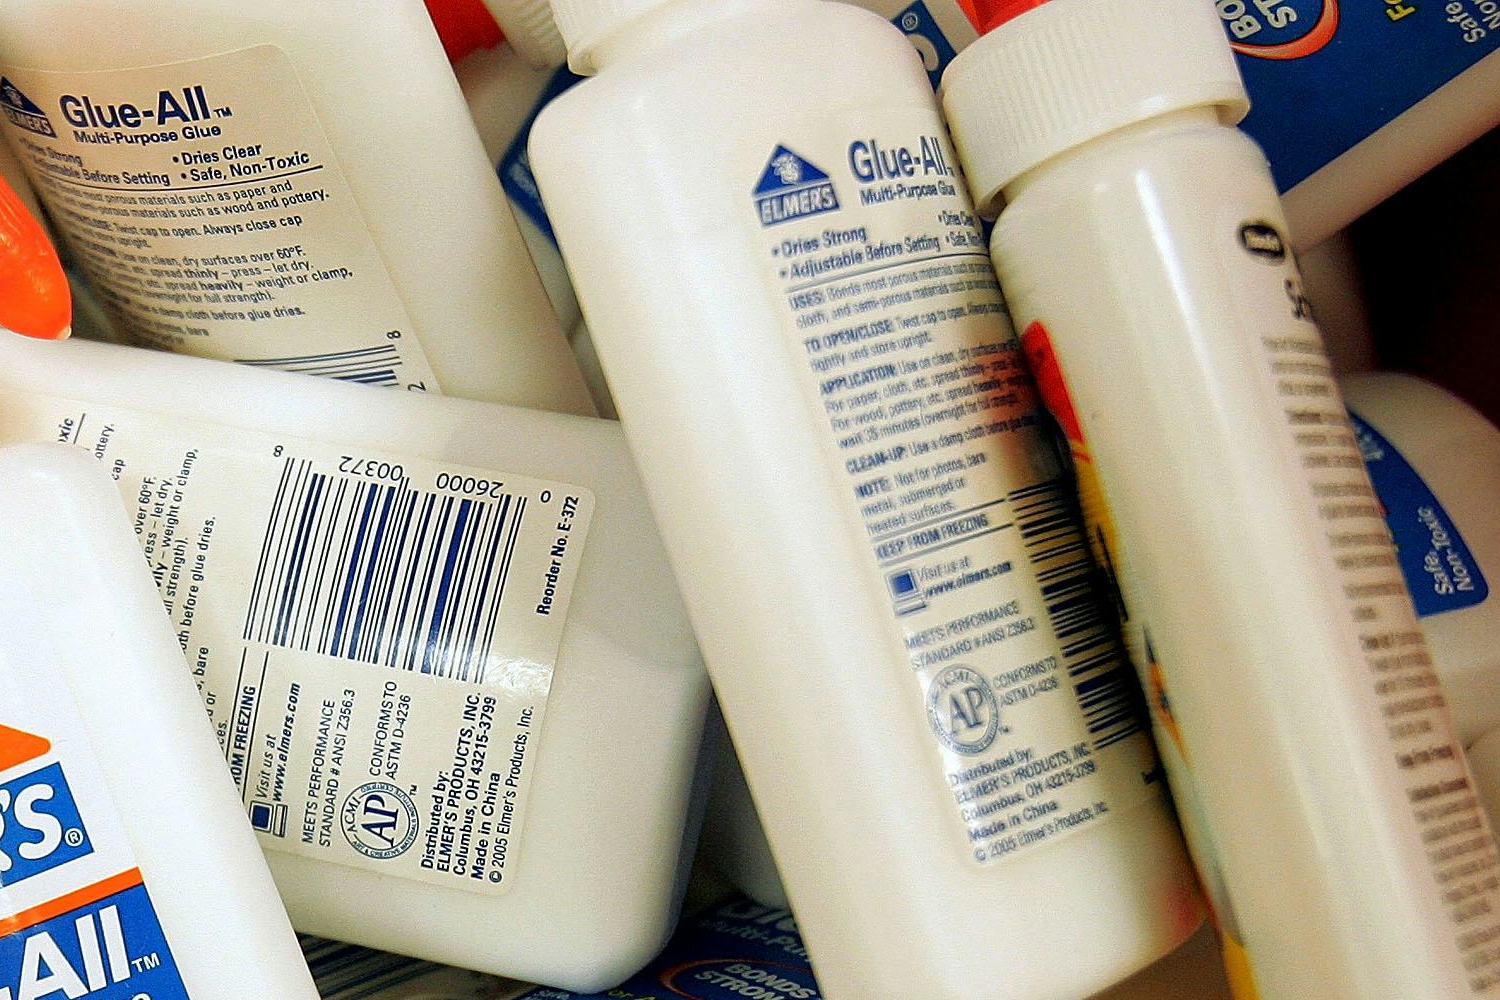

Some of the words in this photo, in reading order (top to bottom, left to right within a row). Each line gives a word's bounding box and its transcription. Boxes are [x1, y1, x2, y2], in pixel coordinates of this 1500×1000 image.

[74, 129, 178, 147] Multi-Purpose
[181, 125, 221, 140] Glue
[181, 150, 219, 166] Dries
[222, 143, 262, 161] Clear
[83, 168, 120, 184] Before
[122, 171, 170, 187] Setting
[190, 166, 227, 183] Safe,
[230, 150, 309, 177] Non-Toxic
[761, 185, 839, 223] ELMER'S
[861, 185, 938, 204] Multi-Purpose
[782, 239, 819, 255] Dries
[823, 228, 867, 246] Strong
[791, 250, 863, 278] Adjustable
[865, 243, 903, 260] Before
[905, 235, 940, 253] Setting
[273, 445, 284, 458] 8
[338, 456, 403, 481] 00372
[436, 473, 503, 498] 26000
[540, 490, 551, 503] 0
[558, 496, 578, 531] E-372
[551, 536, 568, 557] No.
[1417, 507, 1473, 590] Non-Toxic
[536, 560, 561, 614] Reorder
[234, 686, 255, 750] FREEZING
[337, 689, 355, 730] Z356.3
[392, 695, 410, 738] D-4236
[517, 707, 533, 727] Inc.
[266, 734, 276, 748] at
[273, 683, 300, 802] www.elmers.com
[369, 701, 393, 776] CONFORMS
[384, 682, 397, 696] TO
[471, 697, 496, 775] 43215-3799
[263, 752, 273, 767] us
[308, 700, 335, 798] PERFORMANCE
[332, 734, 346, 766] ANSI
[386, 742, 401, 780] ASTM
[505, 732, 530, 787] Products,
[255, 770, 270, 798] Visit
[437, 812, 457, 872] ELMER'S
[447, 728, 472, 808] PRODUCTS,
[463, 693, 480, 721] INC.
[465, 779, 480, 800] OH
[481, 773, 500, 816] China
[302, 802, 317, 843] MEETS
[319, 779, 338, 847] STANDARD
[342, 797, 361, 832] ACMI
[361, 792, 401, 848] AP
[421, 795, 443, 869] Distributed
[433, 771, 449, 791] by:
[478, 822, 491, 834] in
[497, 791, 516, 834] Elmer's
[453, 806, 477, 875] Columbus,
[471, 839, 488, 879] Made
[492, 838, 507, 868] 2005
